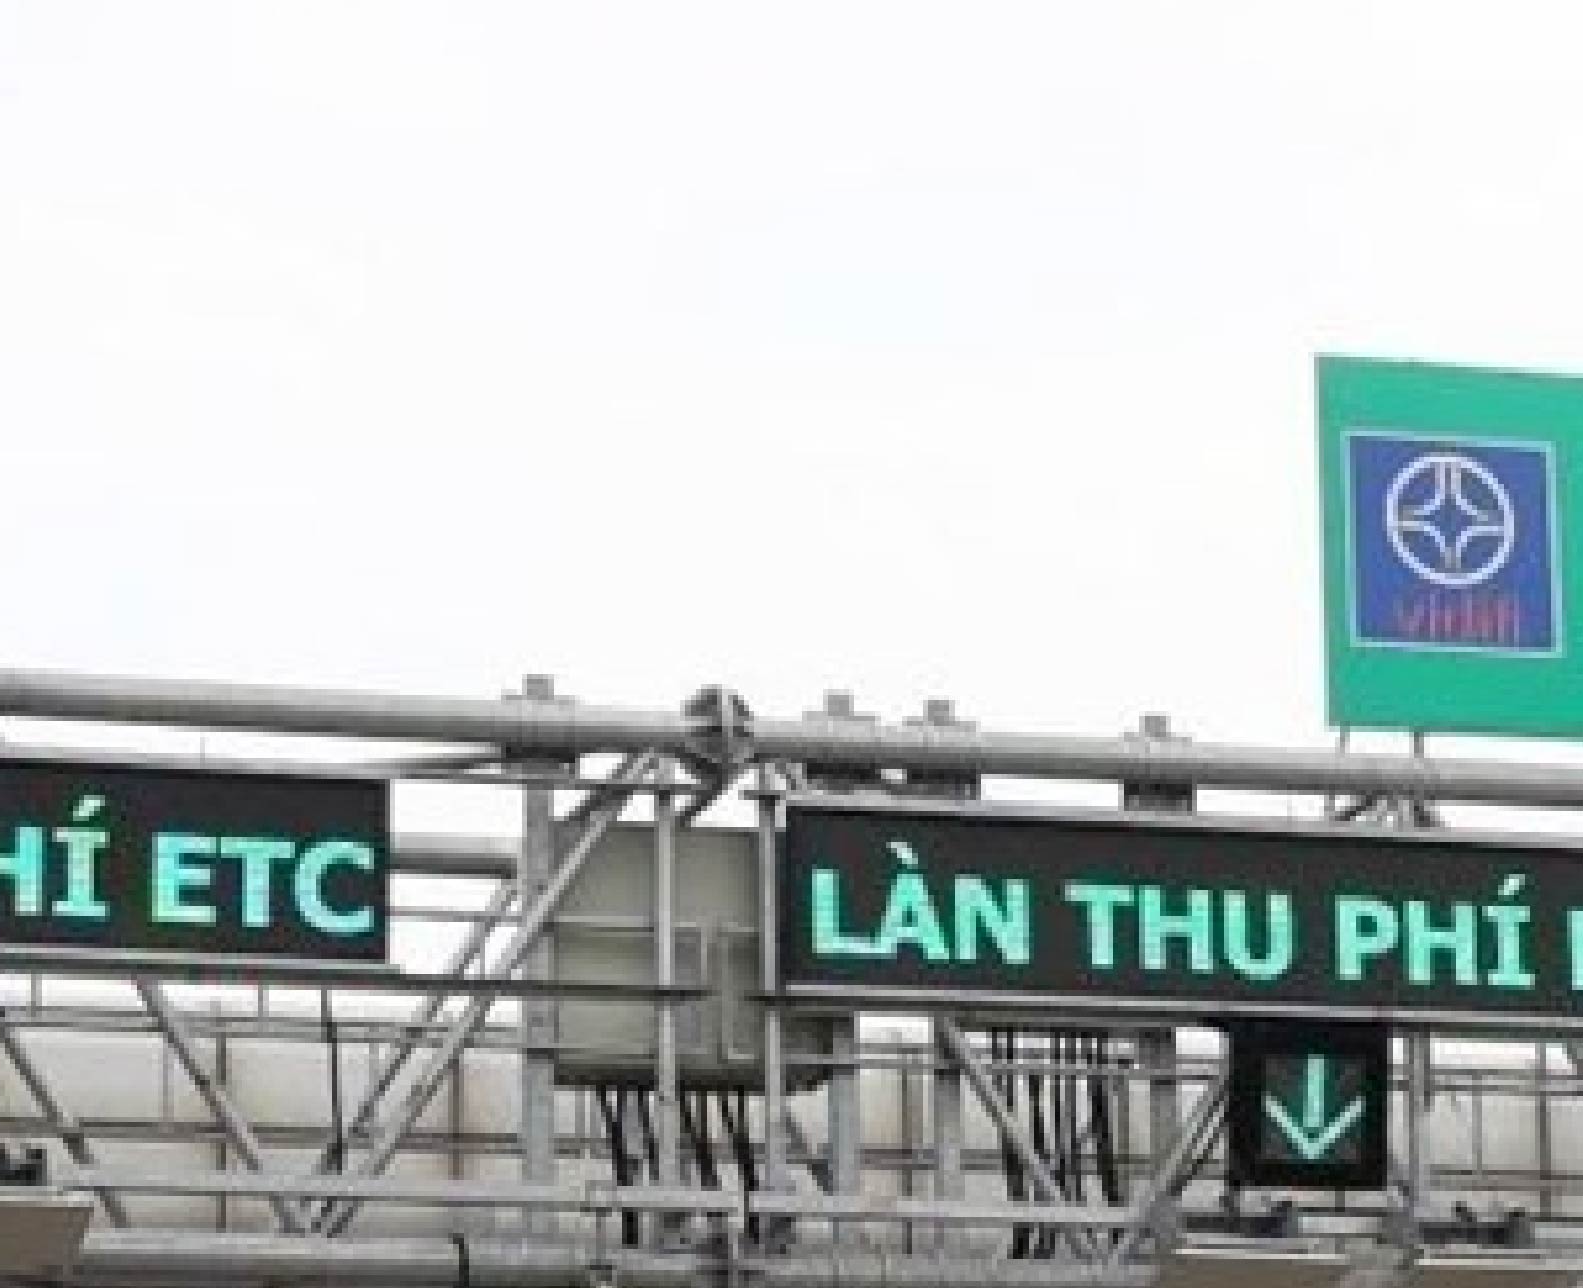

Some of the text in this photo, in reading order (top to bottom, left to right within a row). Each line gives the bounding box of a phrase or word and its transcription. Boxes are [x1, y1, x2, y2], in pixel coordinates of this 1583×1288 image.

[148, 830, 378, 935] ETC
[812, 840, 1031, 966] LÀN
[1064, 882, 1294, 979] THU
[1334, 873, 1535, 989] PHÍ
